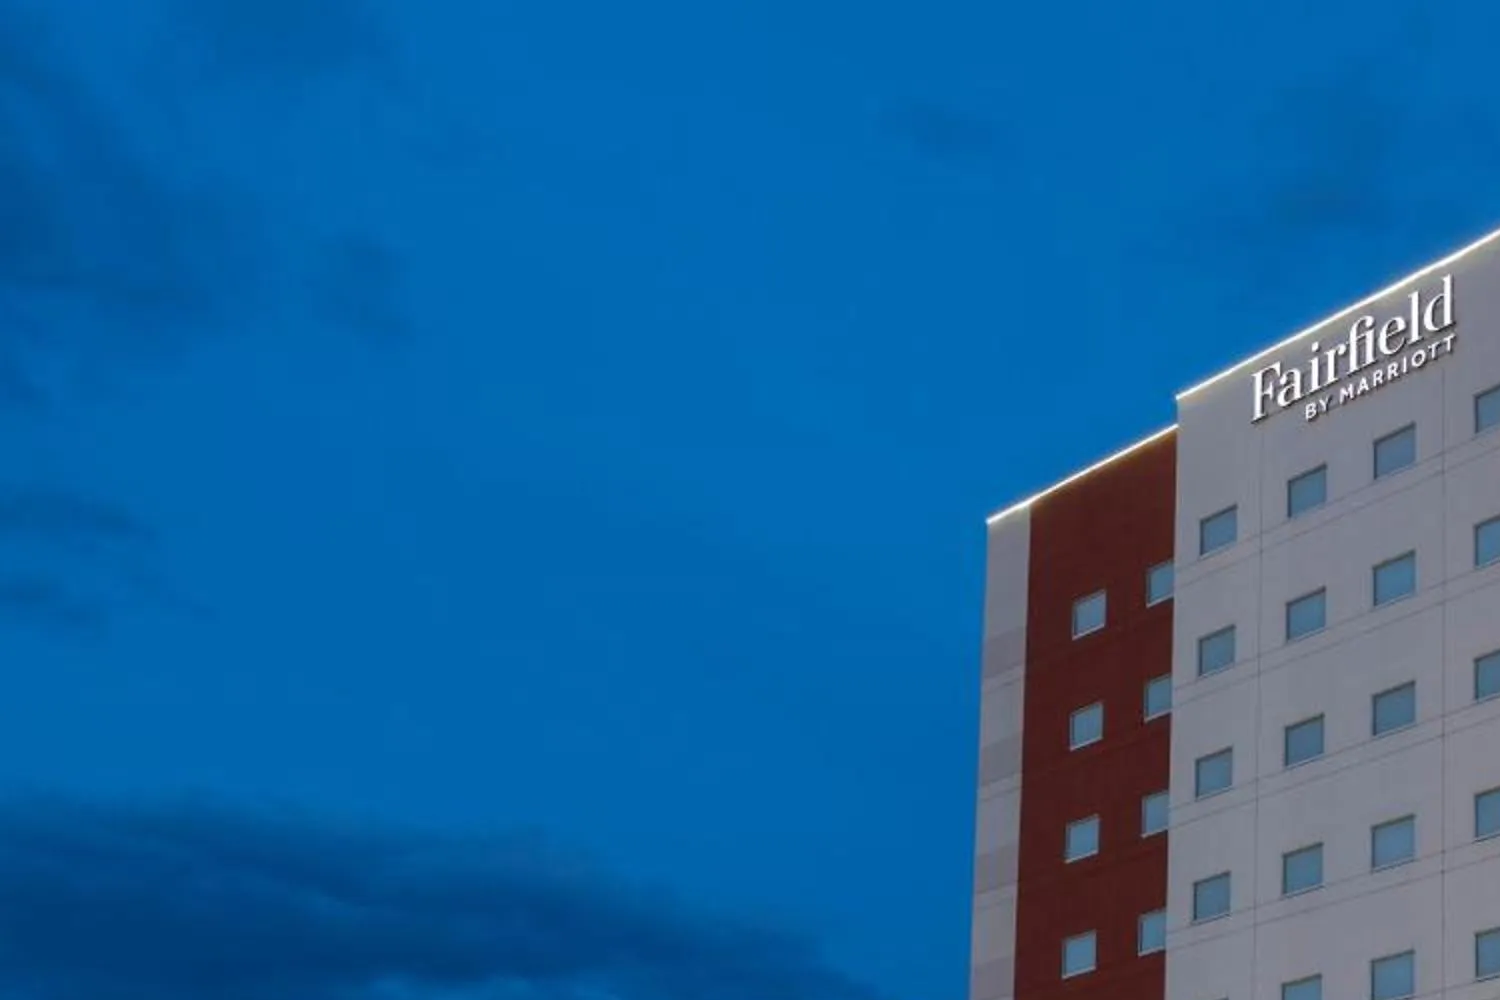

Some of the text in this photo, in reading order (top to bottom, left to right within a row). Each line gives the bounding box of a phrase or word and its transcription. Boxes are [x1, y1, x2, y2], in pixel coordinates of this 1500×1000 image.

[1251, 274, 1454, 422] Fairfield
[1304, 333, 1455, 421] BY MARRIOTT
